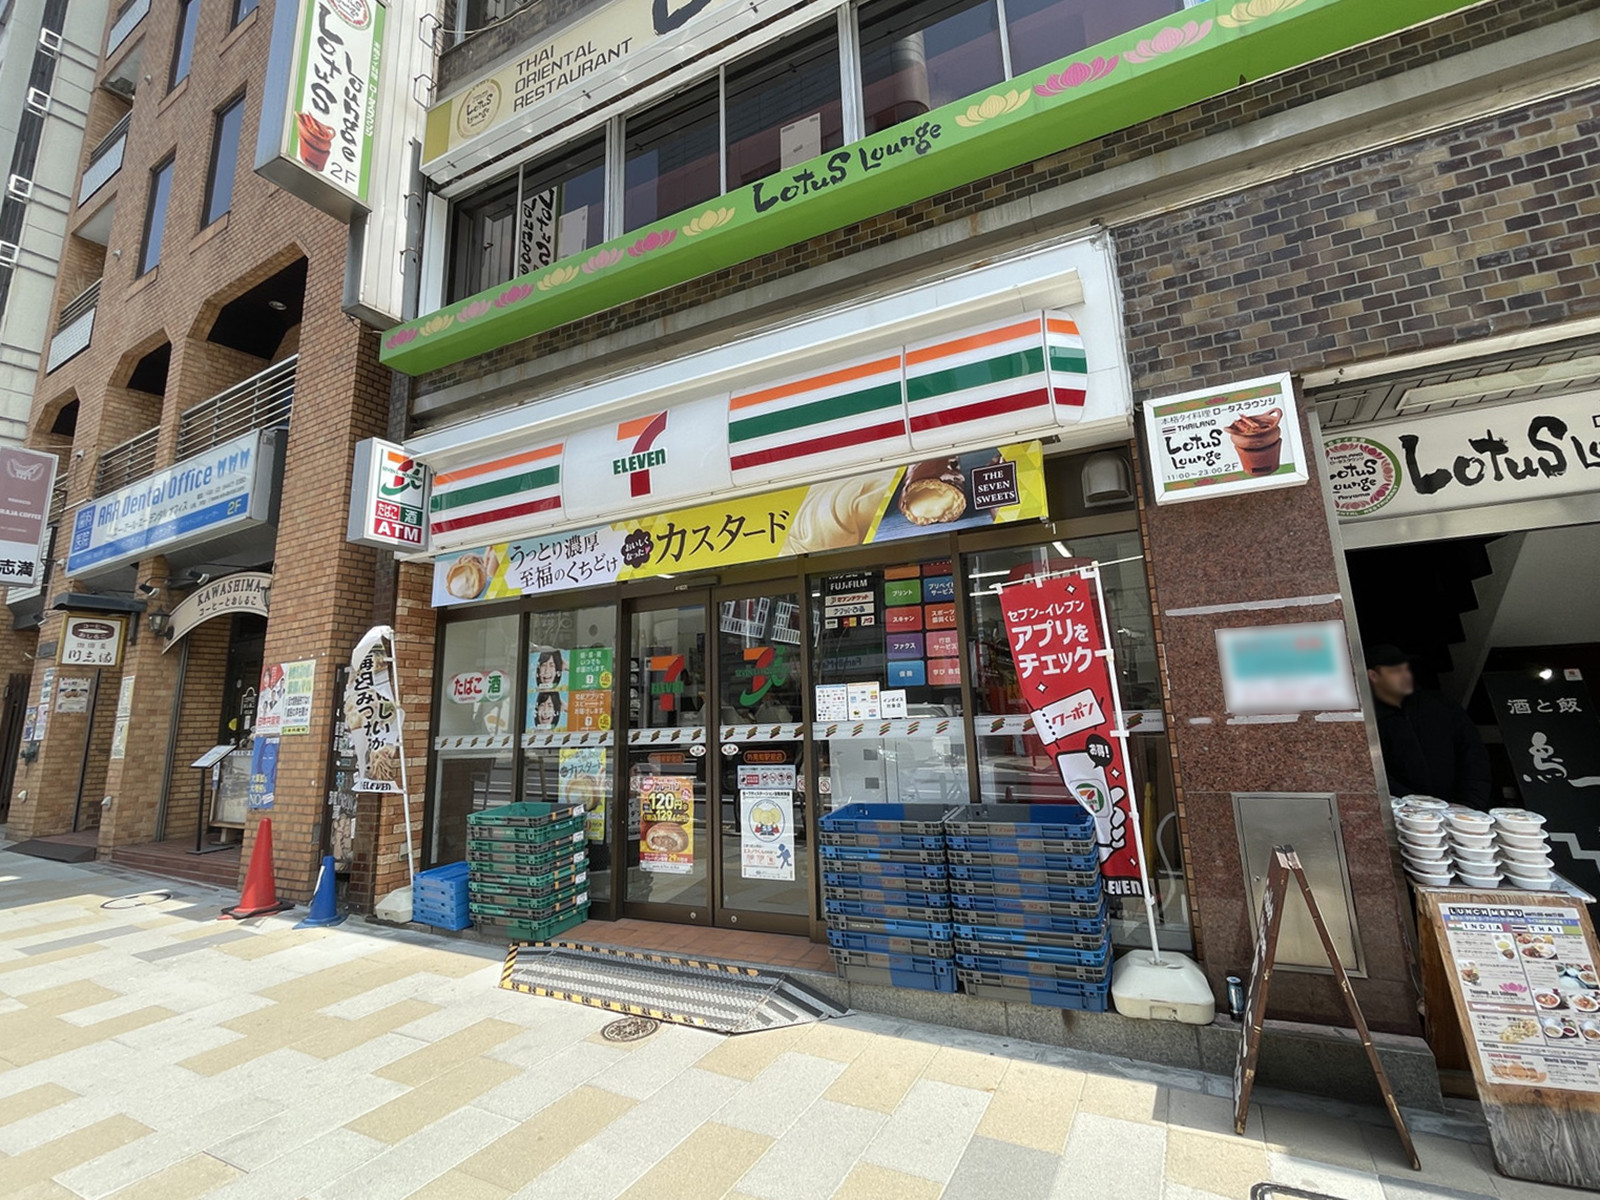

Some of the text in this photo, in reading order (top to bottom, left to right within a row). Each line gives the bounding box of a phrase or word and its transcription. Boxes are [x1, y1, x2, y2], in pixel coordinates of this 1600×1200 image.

[515, 41, 597, 94] ORIENTAL
[516, 45, 555, 76] THAI
[513, 37, 633, 112] RESTAURANT
[859, 121, 942, 172] Lounge
[330, 162, 357, 184] 2F
[1161, 410, 1211, 425] 本格タイ料理
[1178, 419, 1216, 432] THAILAND
[1171, 450, 1221, 470] Lounge
[1224, 462, 1239, 472] 2F
[983, 470, 1004, 481] THE
[122, 483, 165, 517] Dental
[168, 465, 212, 499] Office
[978, 480, 1010, 493] SEVEN
[227, 498, 242, 515] 2F
[976, 490, 1015, 505] SWEETS
[404, 509, 418, 524] 酒
[377, 521, 419, 541] ATM
[655, 510, 790, 565] カスタード
[510, 531, 599, 570] うっとり濃厚
[520, 553, 618, 589] 至福のくちどけ
[197, 578, 260, 606] KAWASHIMA
[830, 579, 868, 590] FUJIFILM
[892, 589, 912, 597] プリント
[1011, 619, 1089, 651] アプリを
[1018, 646, 1092, 679] チェック
[454, 675, 501, 696] たばこ 酒
[1507, 698, 1582, 714] 酒と飯
[1449, 907, 1489, 917] LUNCH
[1464, 922, 1502, 931] INDIA
